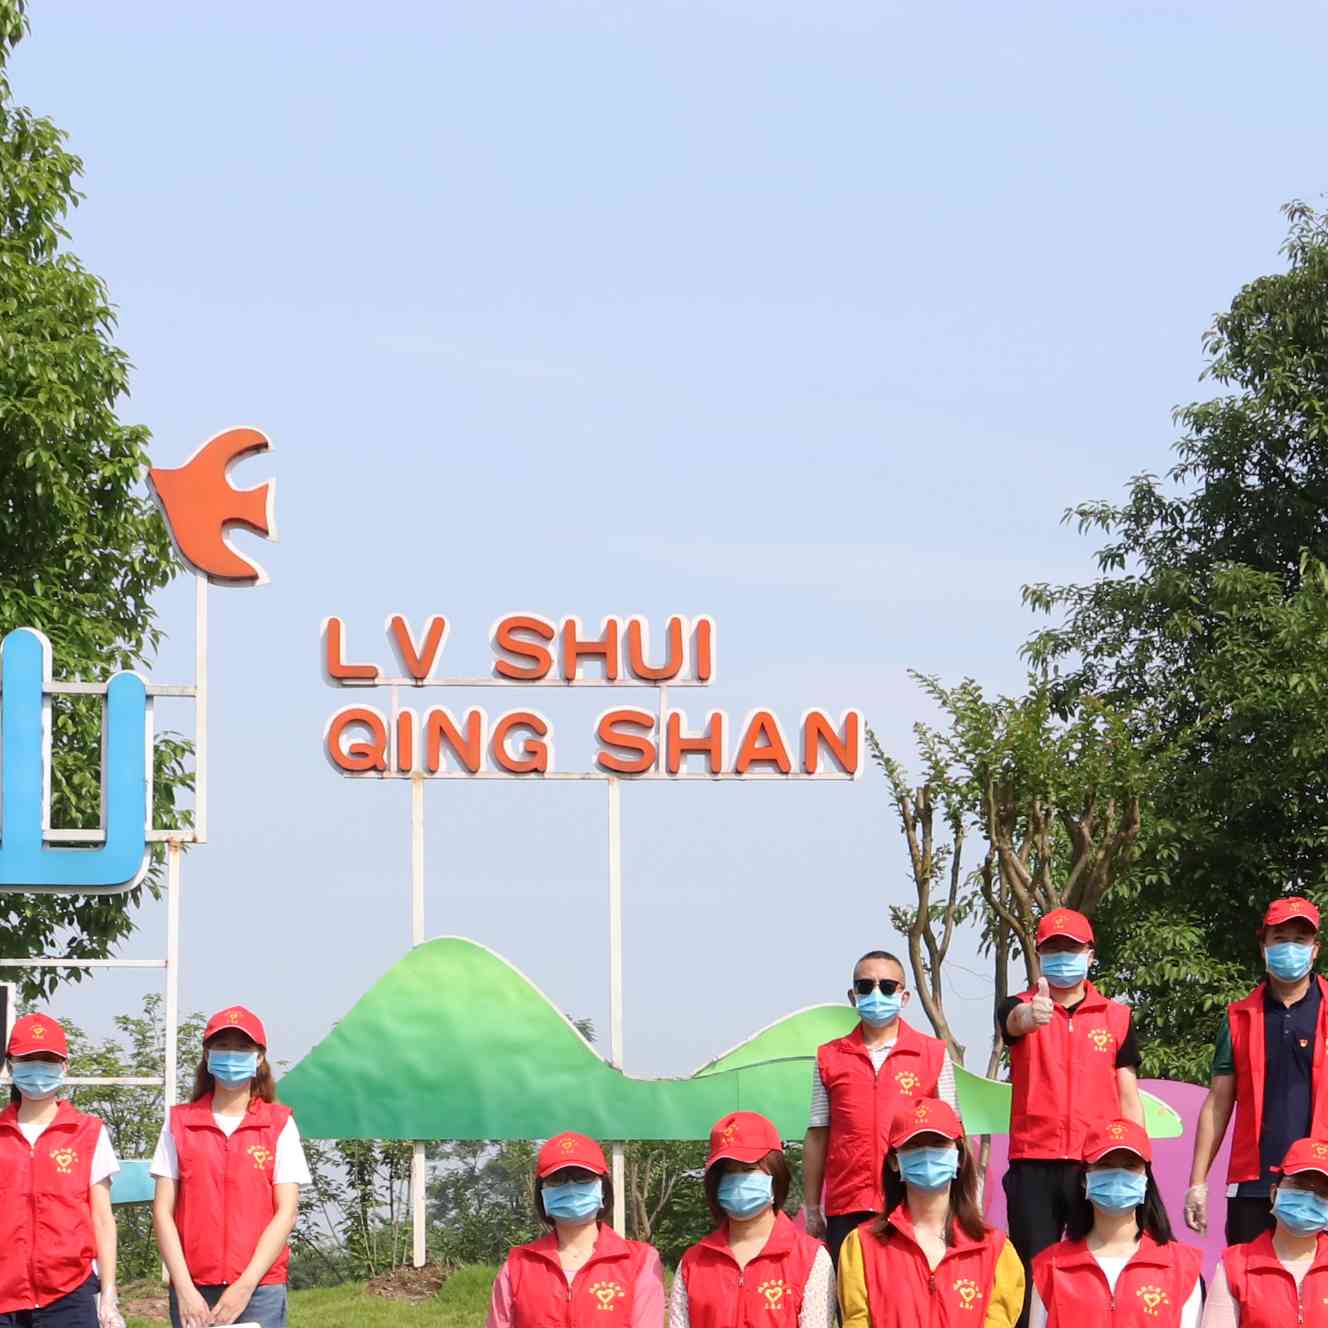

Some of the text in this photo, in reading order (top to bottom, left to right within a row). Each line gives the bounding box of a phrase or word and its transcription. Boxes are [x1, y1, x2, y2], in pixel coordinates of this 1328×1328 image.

[324, 613, 714, 682] LV SHUI
[324, 706, 862, 776] QING SHAN
